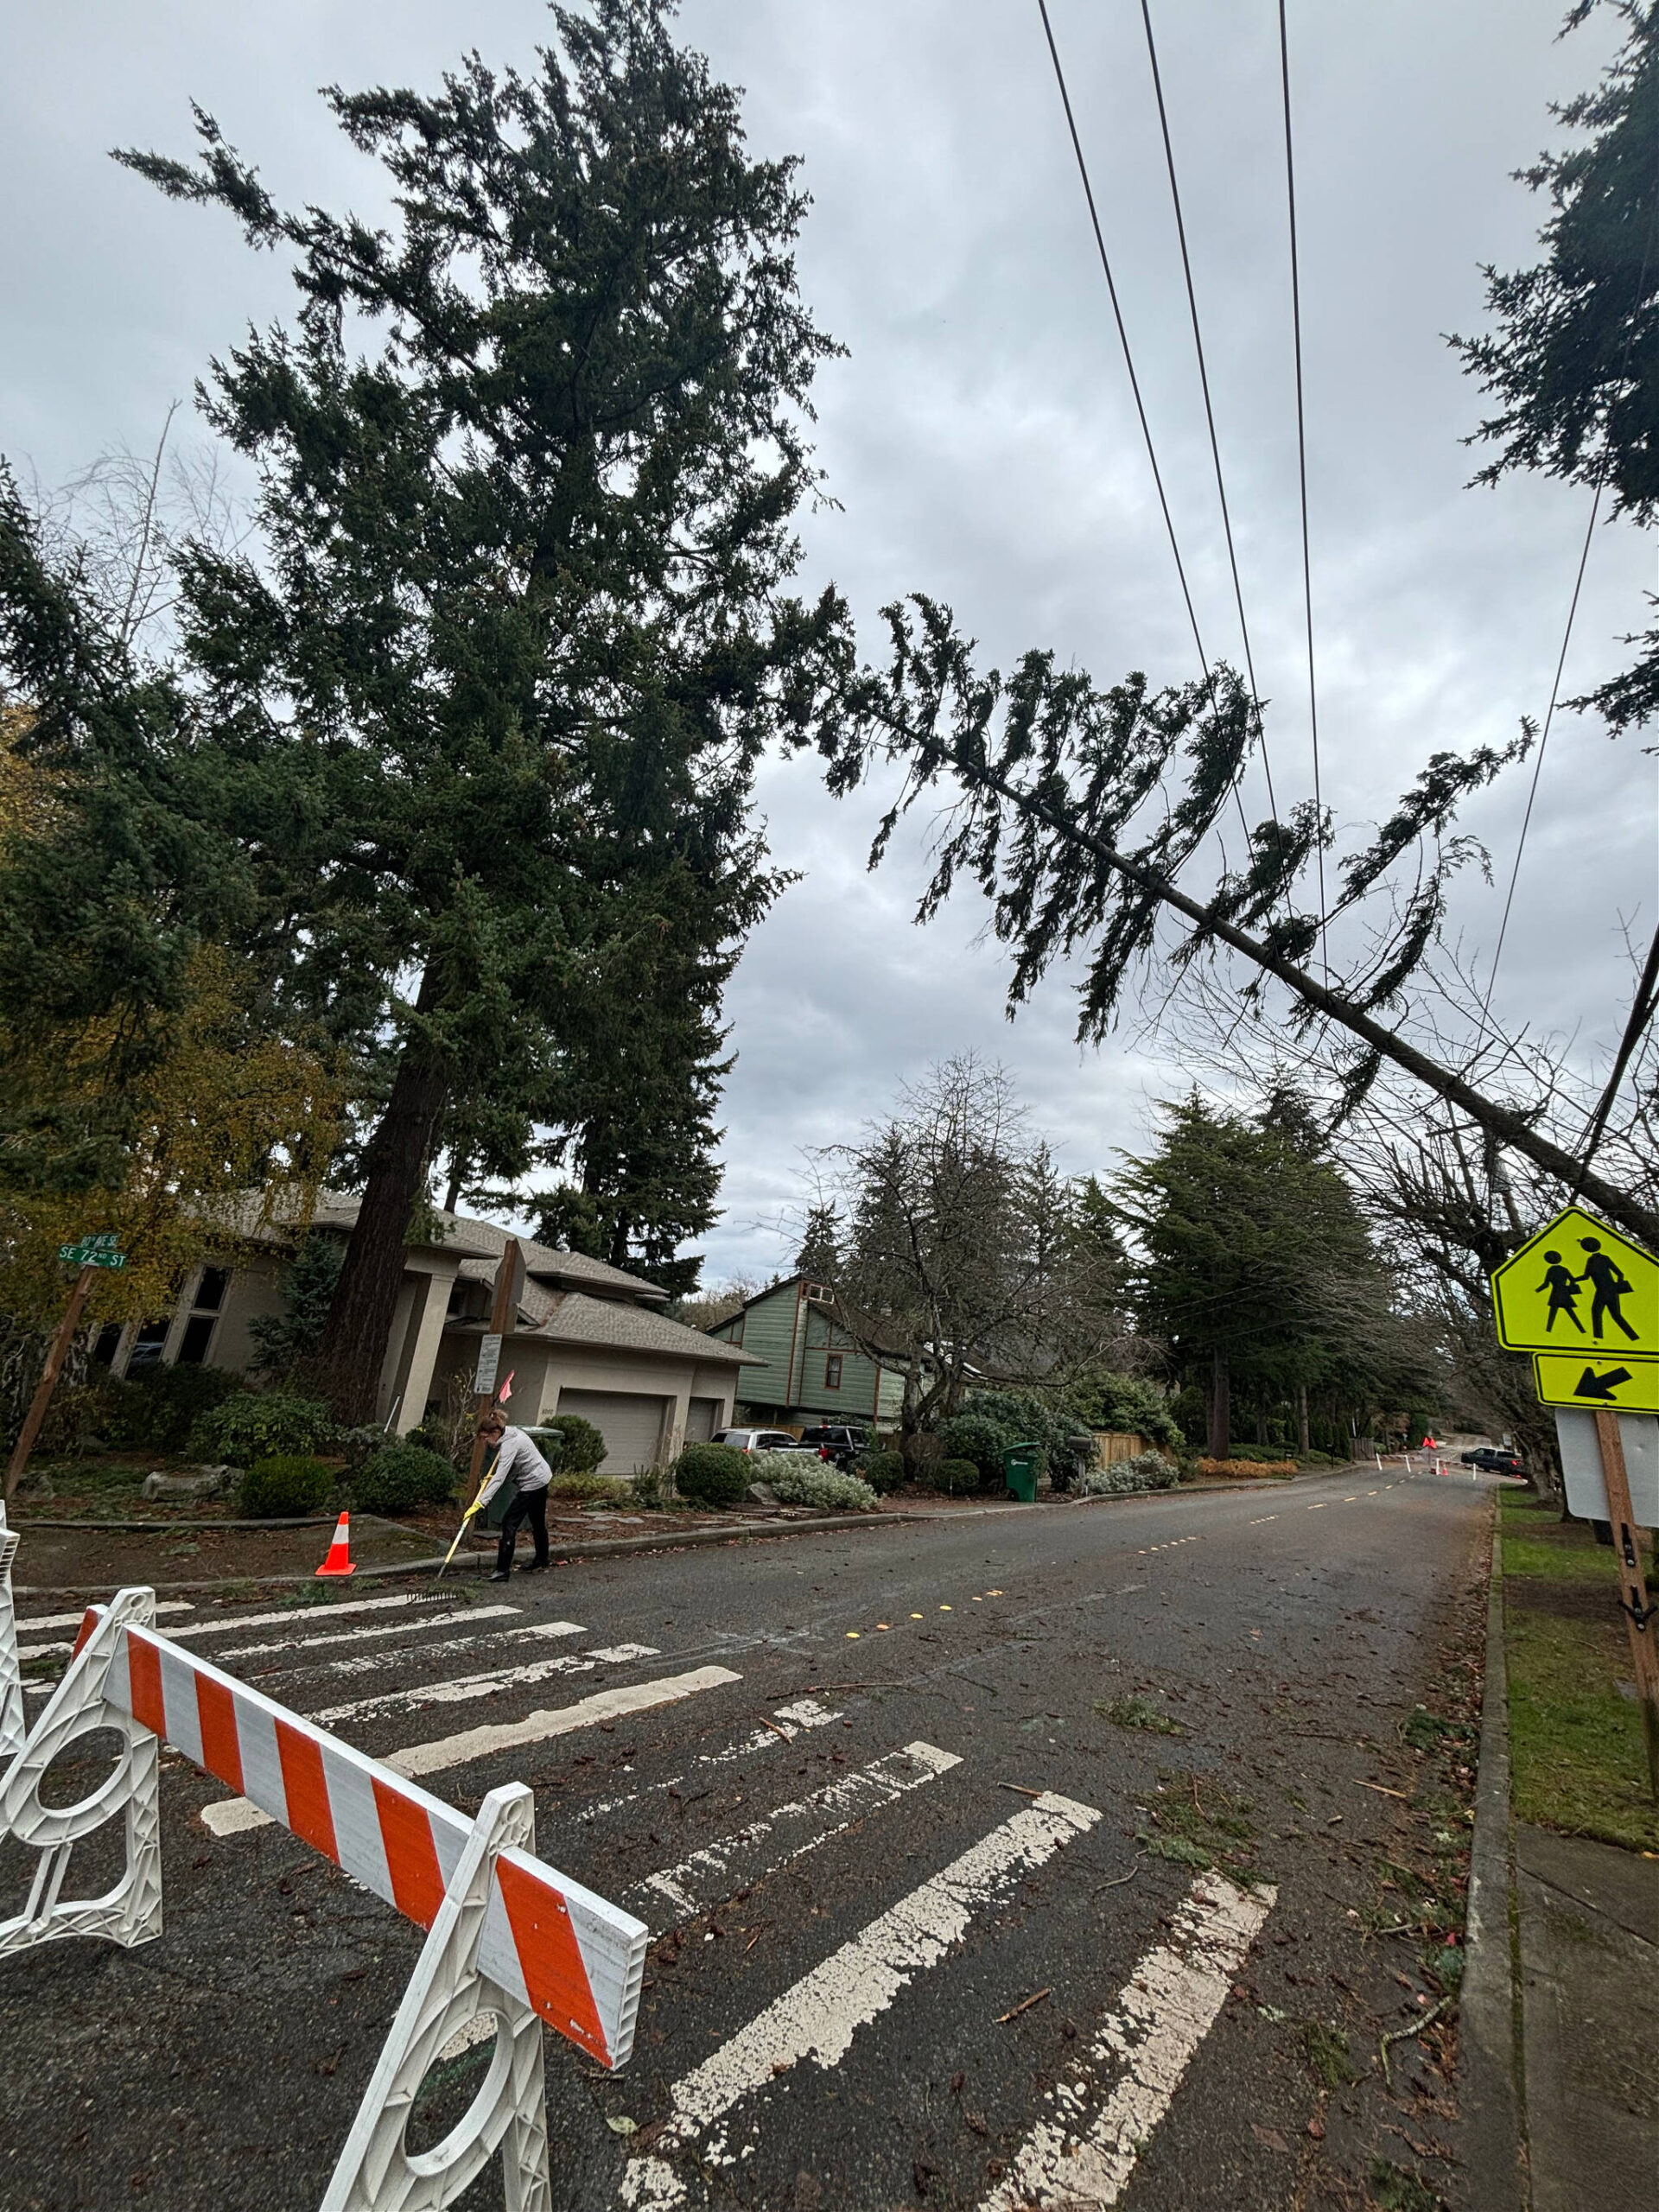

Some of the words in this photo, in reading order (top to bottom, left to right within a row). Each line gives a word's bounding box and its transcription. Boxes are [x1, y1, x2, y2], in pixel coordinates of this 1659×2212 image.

[59, 1246, 76, 1259] SE
[80, 1249, 108, 1262] 72ND
[110, 1255, 126, 1267] ST
